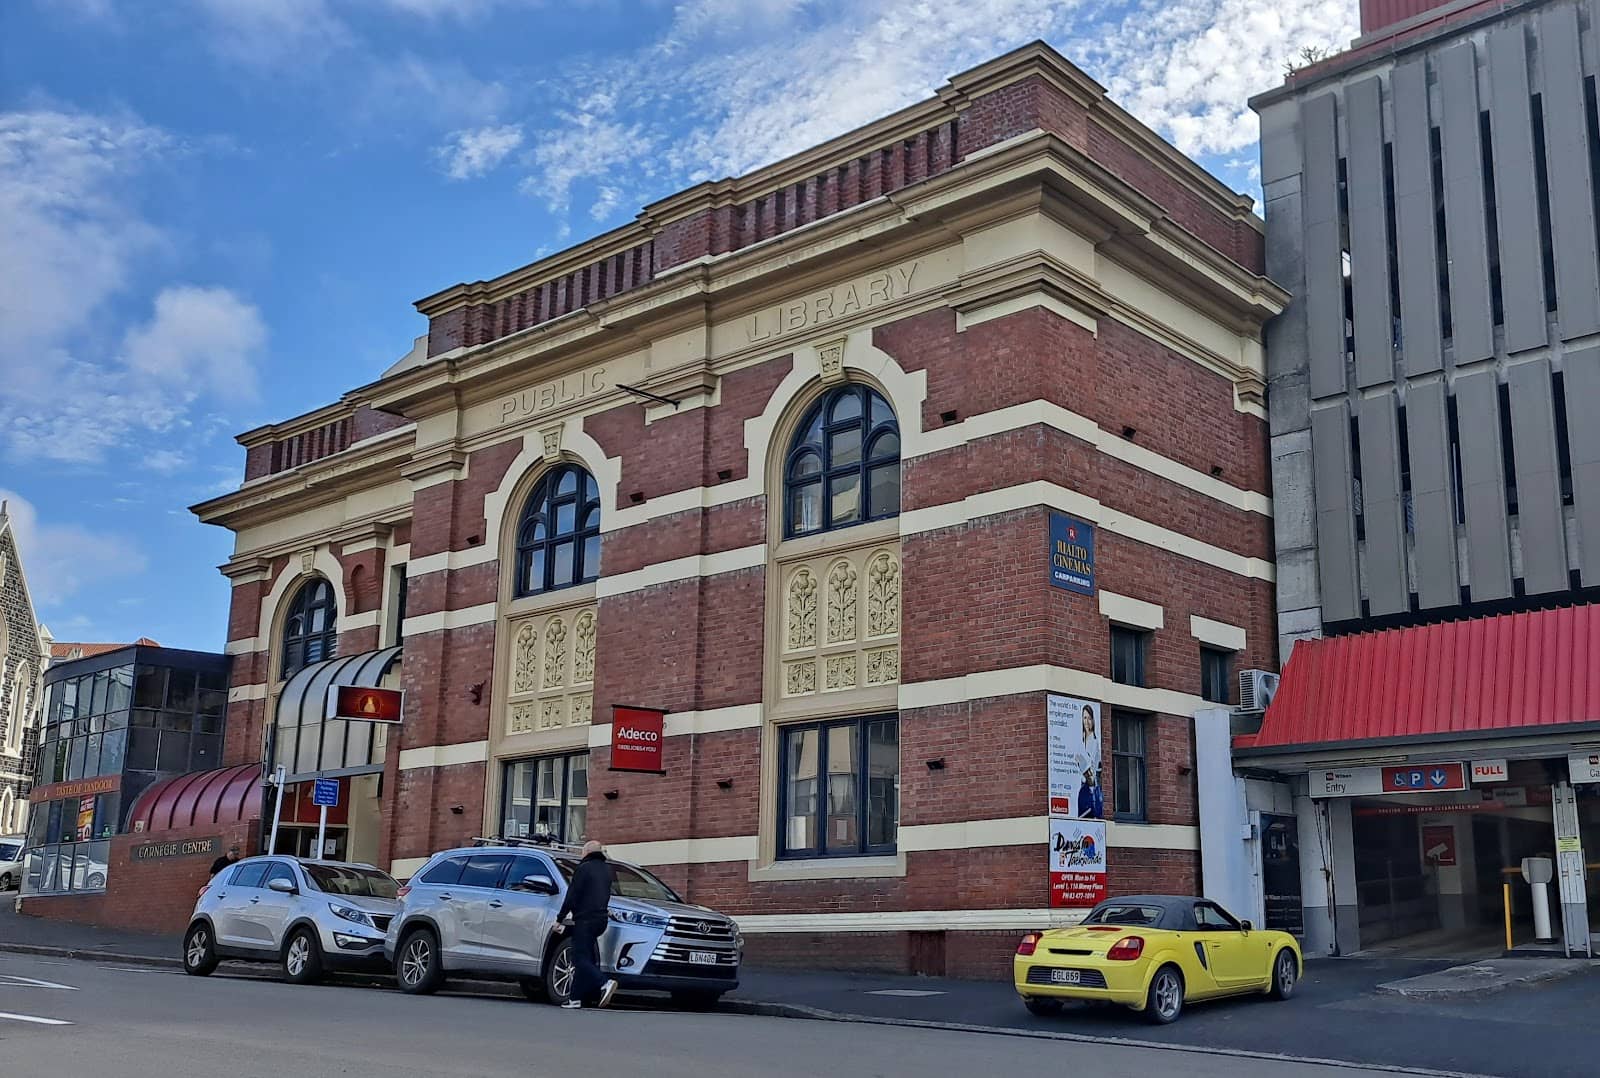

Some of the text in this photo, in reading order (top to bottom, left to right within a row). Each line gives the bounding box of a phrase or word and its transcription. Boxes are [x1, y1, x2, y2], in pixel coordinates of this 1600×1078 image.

[748, 262, 918, 343] LIBRARY
[499, 367, 606, 424] PUBLIC
[1057, 540, 1087, 560] RIALTO
[1053, 553, 1091, 575] CINEMAS
[617, 727, 658, 742] Adecco
[1475, 766, 1504, 775] FULL
[56, 779, 113, 796] TASTE OF TANDOOR
[1326, 783, 1346, 793] Entry
[138, 840, 212, 858] CARNEGIE CENTRE
[1053, 882, 1065, 890] Level
[1052, 970, 1079, 981] EGL859
